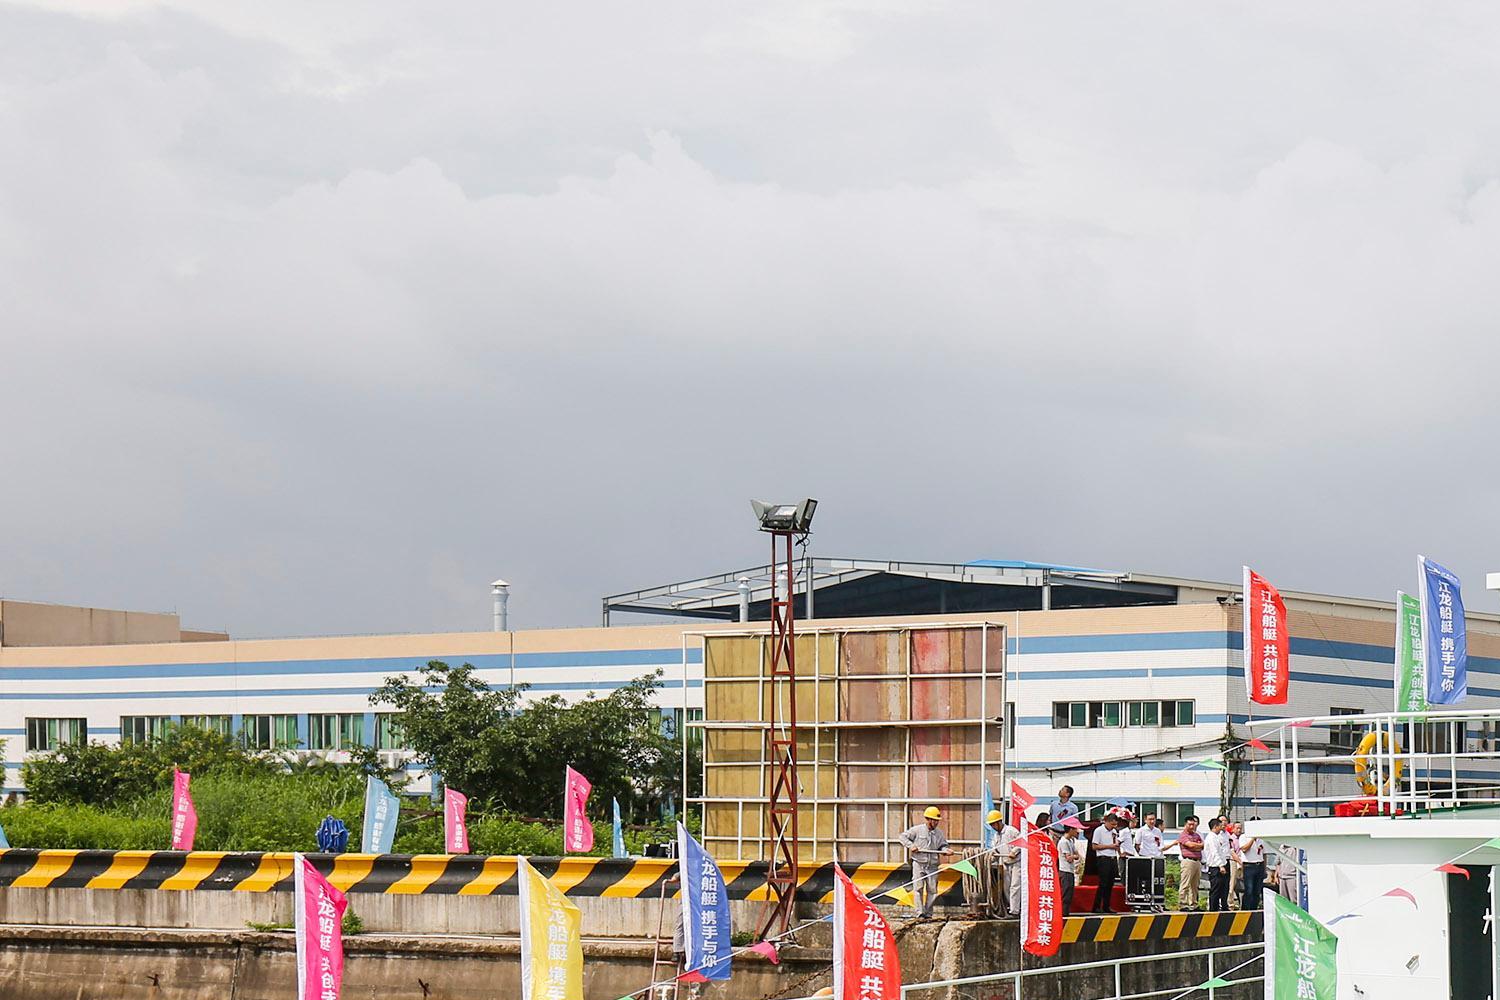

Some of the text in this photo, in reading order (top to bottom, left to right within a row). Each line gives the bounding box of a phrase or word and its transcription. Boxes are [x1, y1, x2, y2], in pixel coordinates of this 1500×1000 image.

[1261, 590, 1278, 697] 江龙船艇 共创未来
[1438, 581, 1454, 633] 江龙船艇
[1440, 637, 1456, 692] 携手与你
[701, 856, 718, 968] 龙船艇 携手与你
[1037, 840, 1055, 947] 江龙船艇 共创未来
[861, 906, 886, 971] 龙船艇
